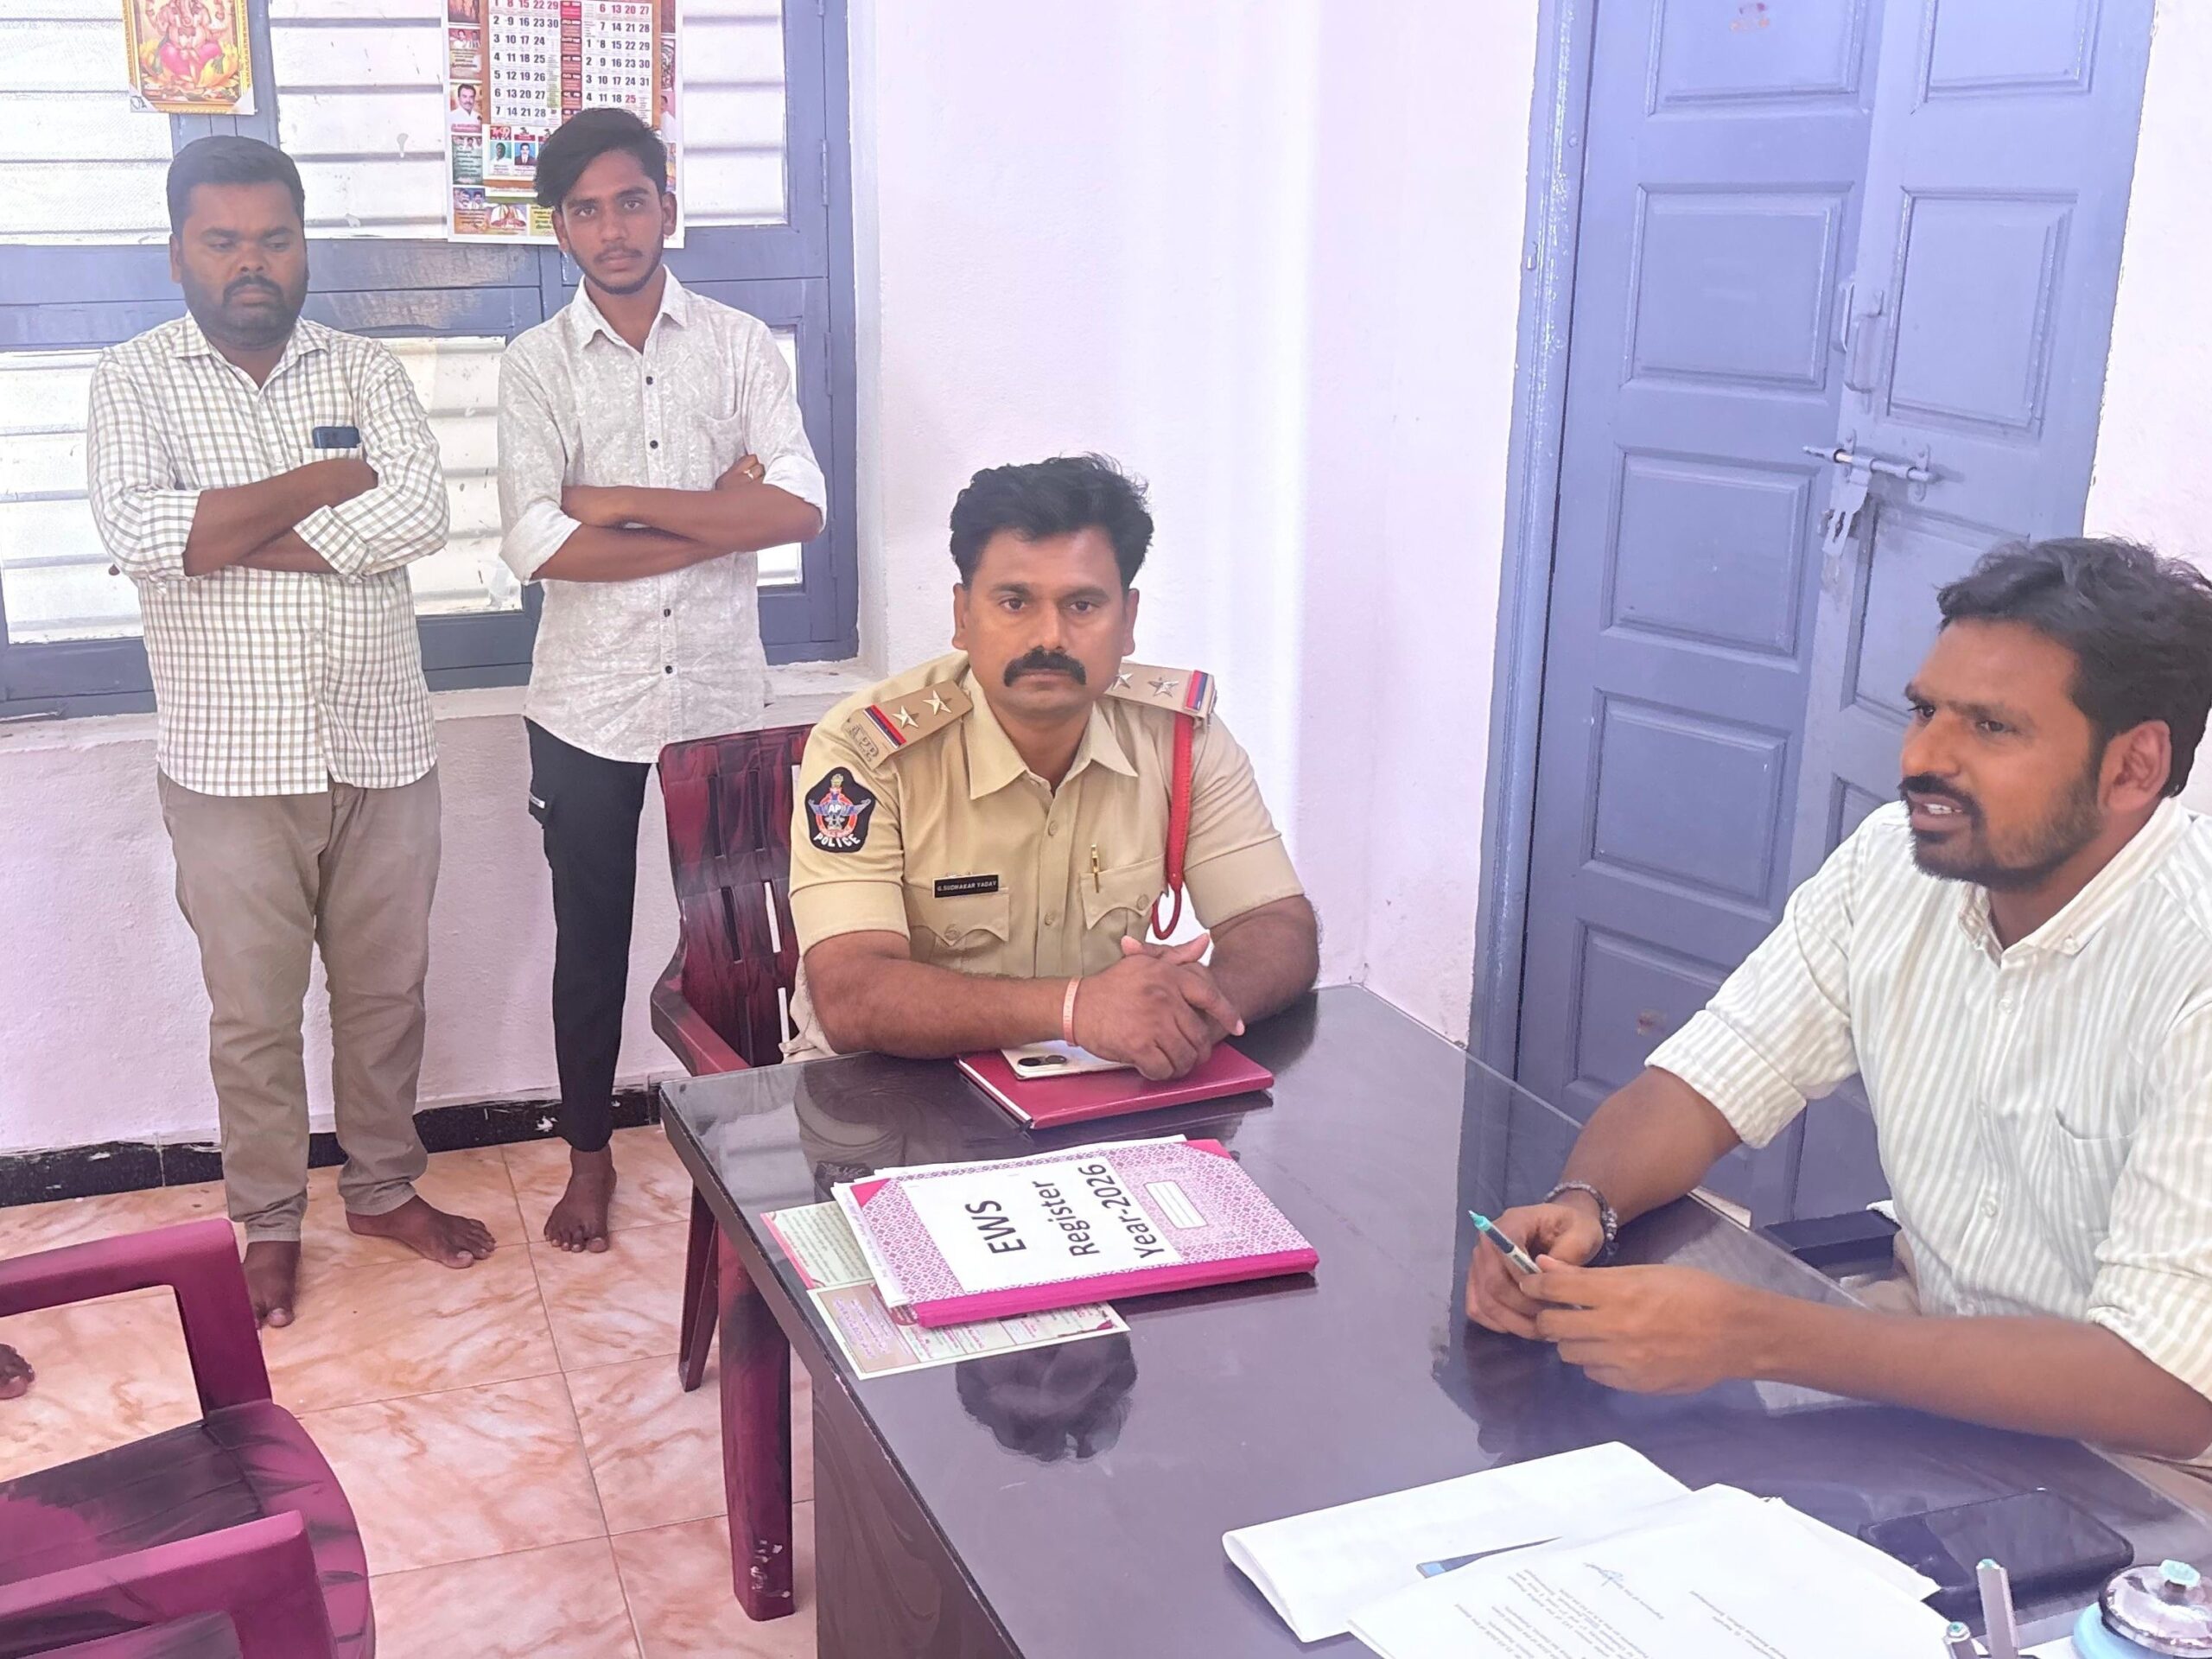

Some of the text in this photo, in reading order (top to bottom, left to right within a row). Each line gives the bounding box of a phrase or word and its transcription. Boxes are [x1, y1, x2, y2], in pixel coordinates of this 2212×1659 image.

[519, 0, 530, 9] 15
[533, 1, 545, 10] 22
[547, 2, 559, 10] 29
[599, 4, 650, 15] 6 13 20 27
[493, 16, 559, 29] 2 9 16 23 30
[600, 22, 650, 33] 7 14 21 28
[493, 35, 545, 46] 3 10 17 24
[587, 40, 650, 51] 1 8 15 22 29
[493, 53, 546, 64] 4 11 18 25
[585, 57, 651, 69] 2 9 16 23 30
[493, 71, 546, 82] 5 12 19 26
[585, 75, 650, 86] 3 10 17 24 31
[494, 89, 546, 100] 6 13 20 27
[586, 93, 637, 105] 4 11 18 25
[495, 107, 501, 116] 7
[507, 107, 518, 117] 14
[521, 108, 531, 117] 21
[535, 109, 547, 118] 28
[828, 804, 842, 813] AP
[813, 832, 861, 848] POLICE
[1077, 1164, 1165, 1259] Year-2026
[1032, 1180, 1100, 1256] Register
[964, 1200, 1027, 1254] EWS
